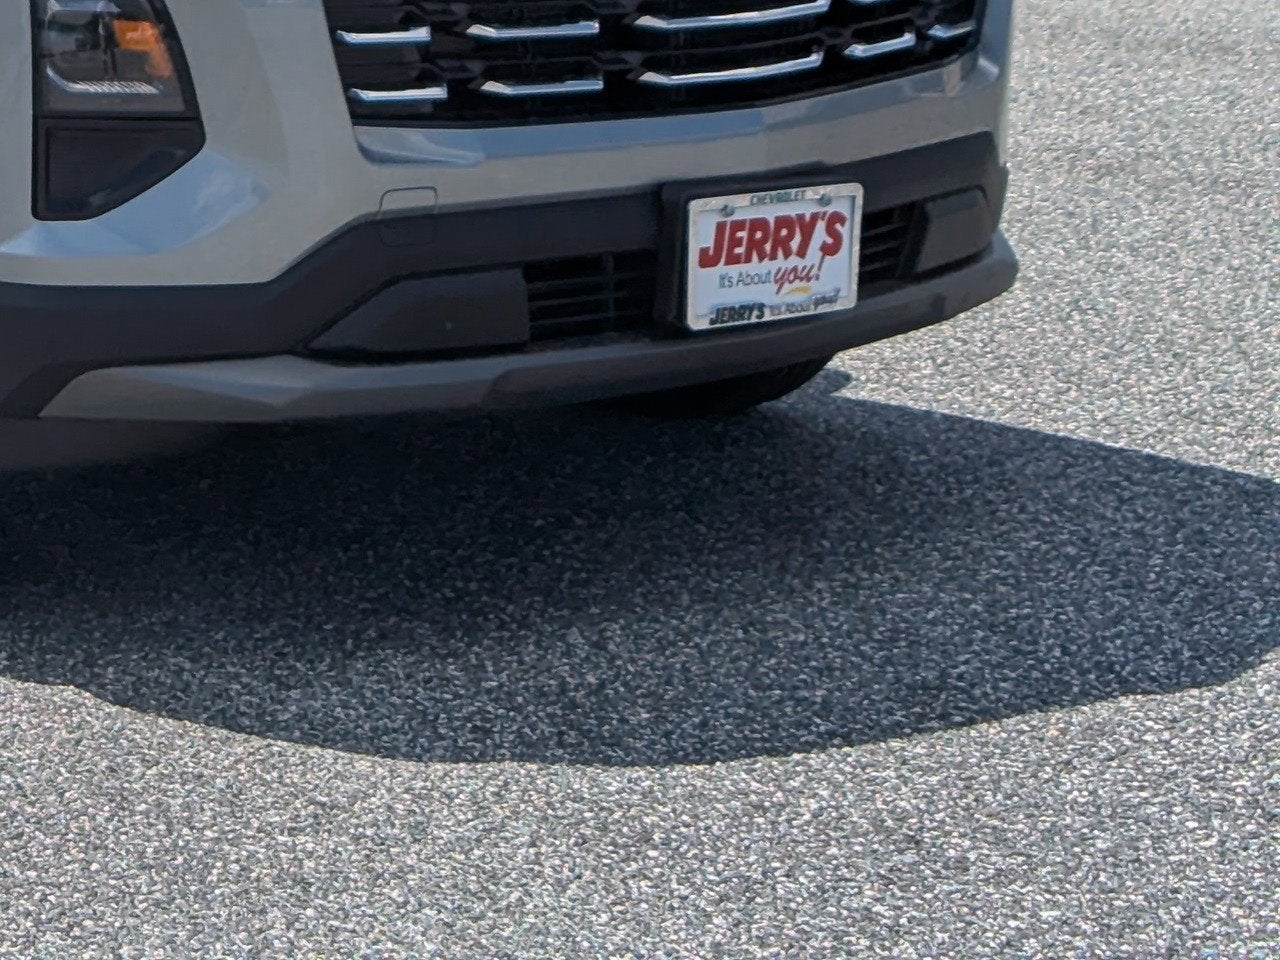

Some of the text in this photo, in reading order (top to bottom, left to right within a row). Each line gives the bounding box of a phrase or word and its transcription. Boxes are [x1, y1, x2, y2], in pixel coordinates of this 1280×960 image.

[750, 190, 805, 205] CHEVROLET
[698, 210, 848, 269] JERRY'S
[719, 255, 824, 294] It's About you!
[709, 302, 766, 325] JERRY'S
